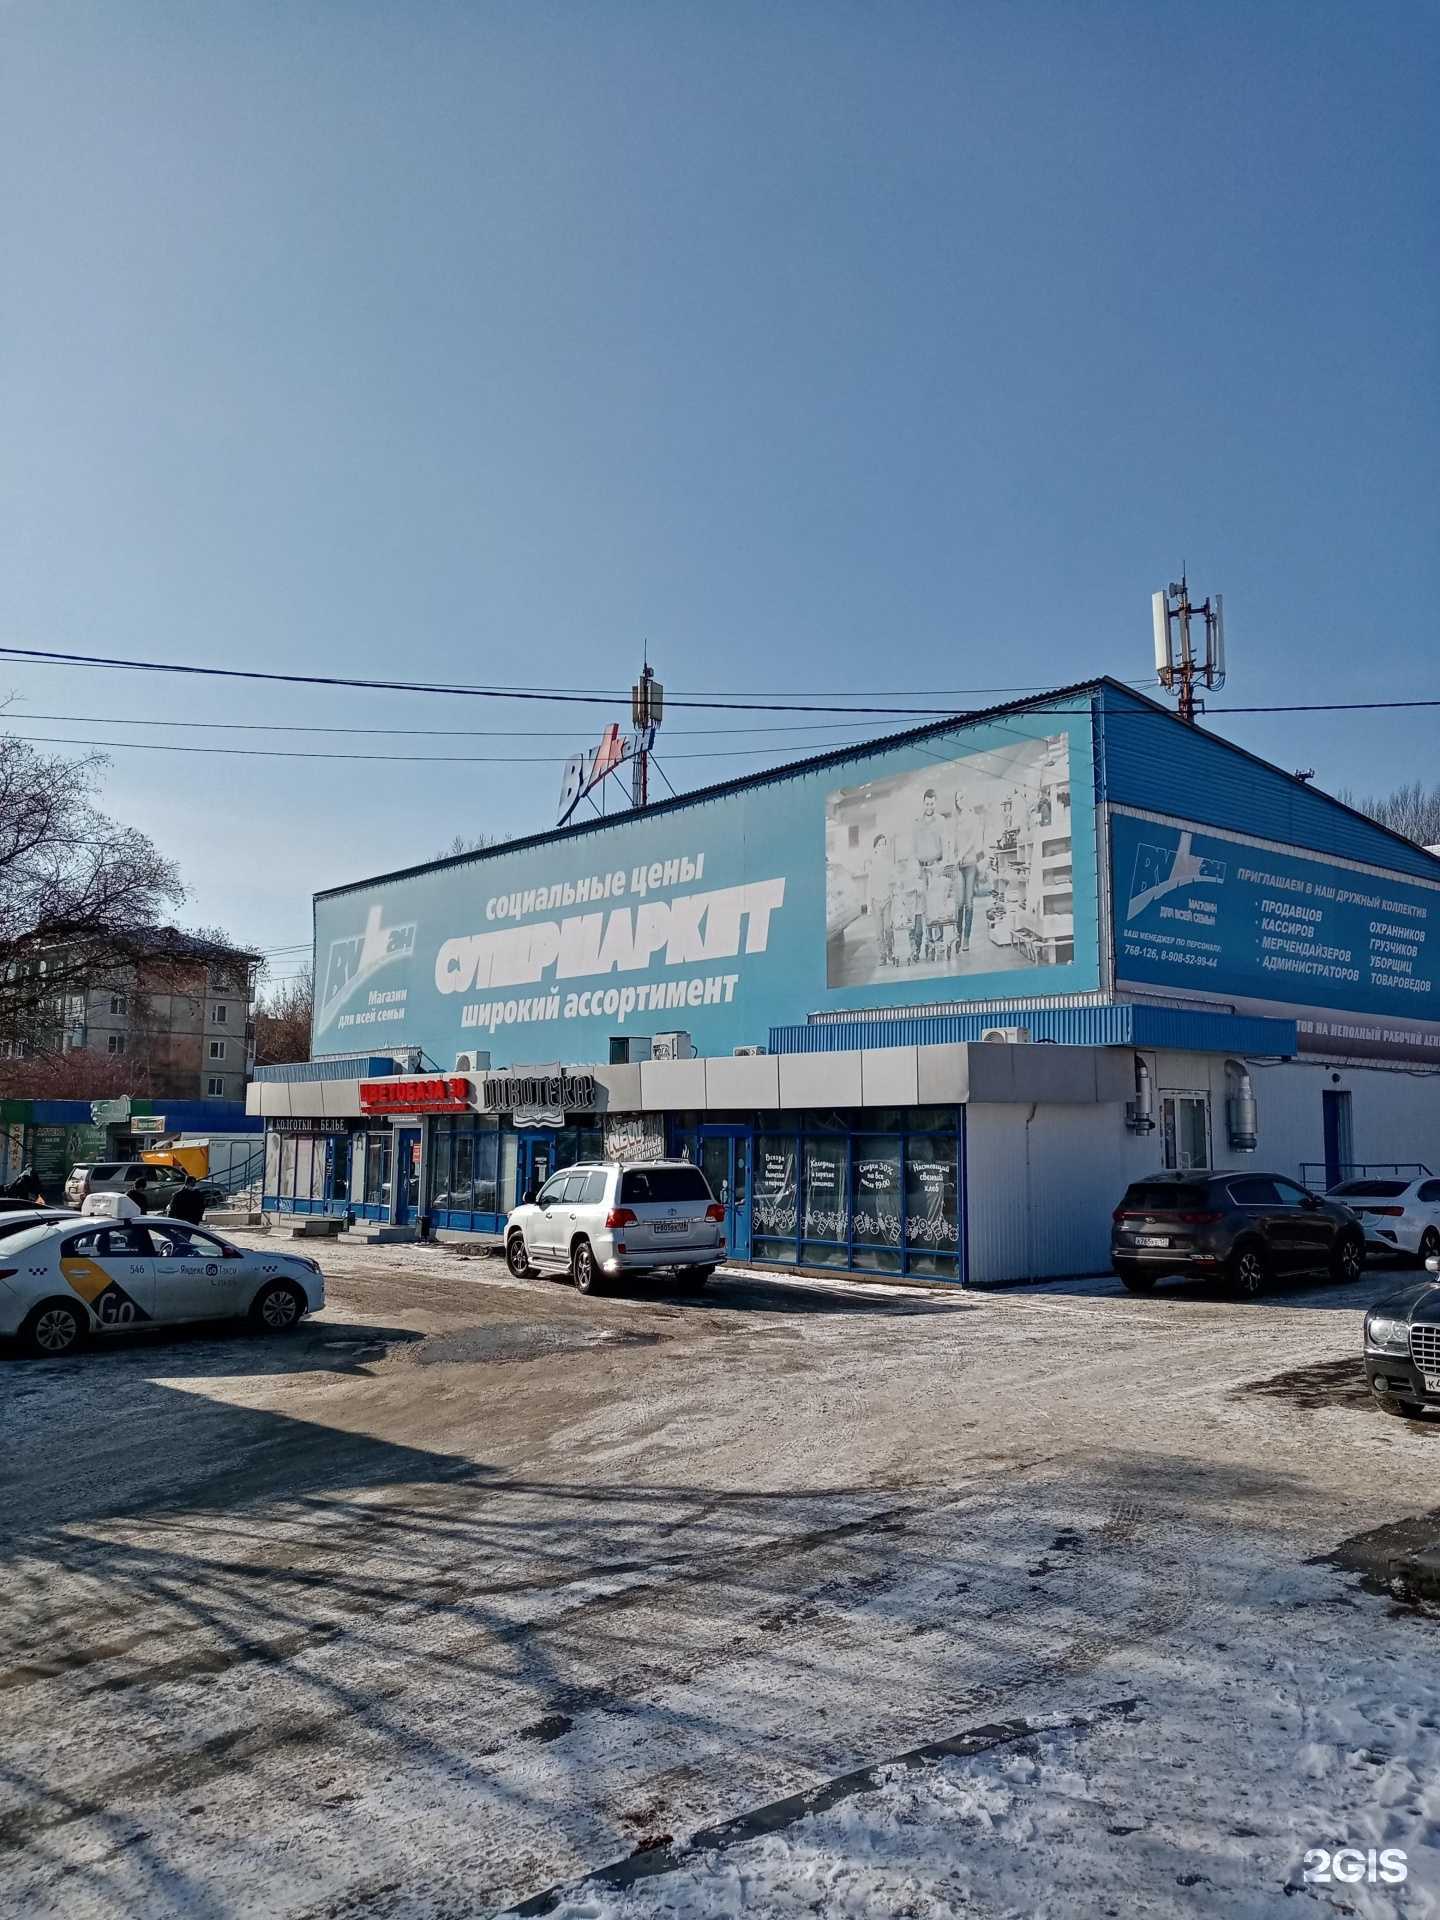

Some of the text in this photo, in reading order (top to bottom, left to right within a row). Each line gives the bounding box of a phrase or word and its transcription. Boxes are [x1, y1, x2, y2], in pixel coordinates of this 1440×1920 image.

[486, 854, 705, 920] социальные цены
[1237, 868, 1428, 919] ПРИГЛАШАЕМ В НАШ ДРУЖНЫЙ КОЛЛЕКТИВ
[1261, 900, 1323, 922] ПРОДАВЦОВ
[435, 877, 786, 994] СУПЕРМАРКЕТ
[1261, 918, 1315, 938] КАССИРОВ
[1369, 921, 1426, 942] ОХРАННИКОВ
[1262, 936, 1352, 962] МЕРЧЕНДАЙЗЕРОВ
[1369, 938, 1418, 957] ГРУЗЧИКОВ
[1263, 955, 1360, 982] АДМИНИСТРАТОРОВ
[1369, 955, 1413, 974] УБОРЩИЦ
[1371, 973, 1432, 993] ТОВАРОВЕДОВ
[368, 989, 408, 1005] Магазин
[461, 974, 740, 1029] широкий ассортимент
[338, 1008, 405, 1031] для всей семьи
[1315, 1022, 1329, 1036] НА
[1330, 1024, 1381, 1041] НЕПОЛНЫЙ
[1383, 1030, 1423, 1046] РАБОЧИЙ
[483, 1075, 595, 1111] ПИВОТЕКА
[275, 1119, 345, 1131] КОЛГОТКИ БЕЛЬЕ
[130, 1264, 145, 1274] 546
[99, 1292, 136, 1324] Go
